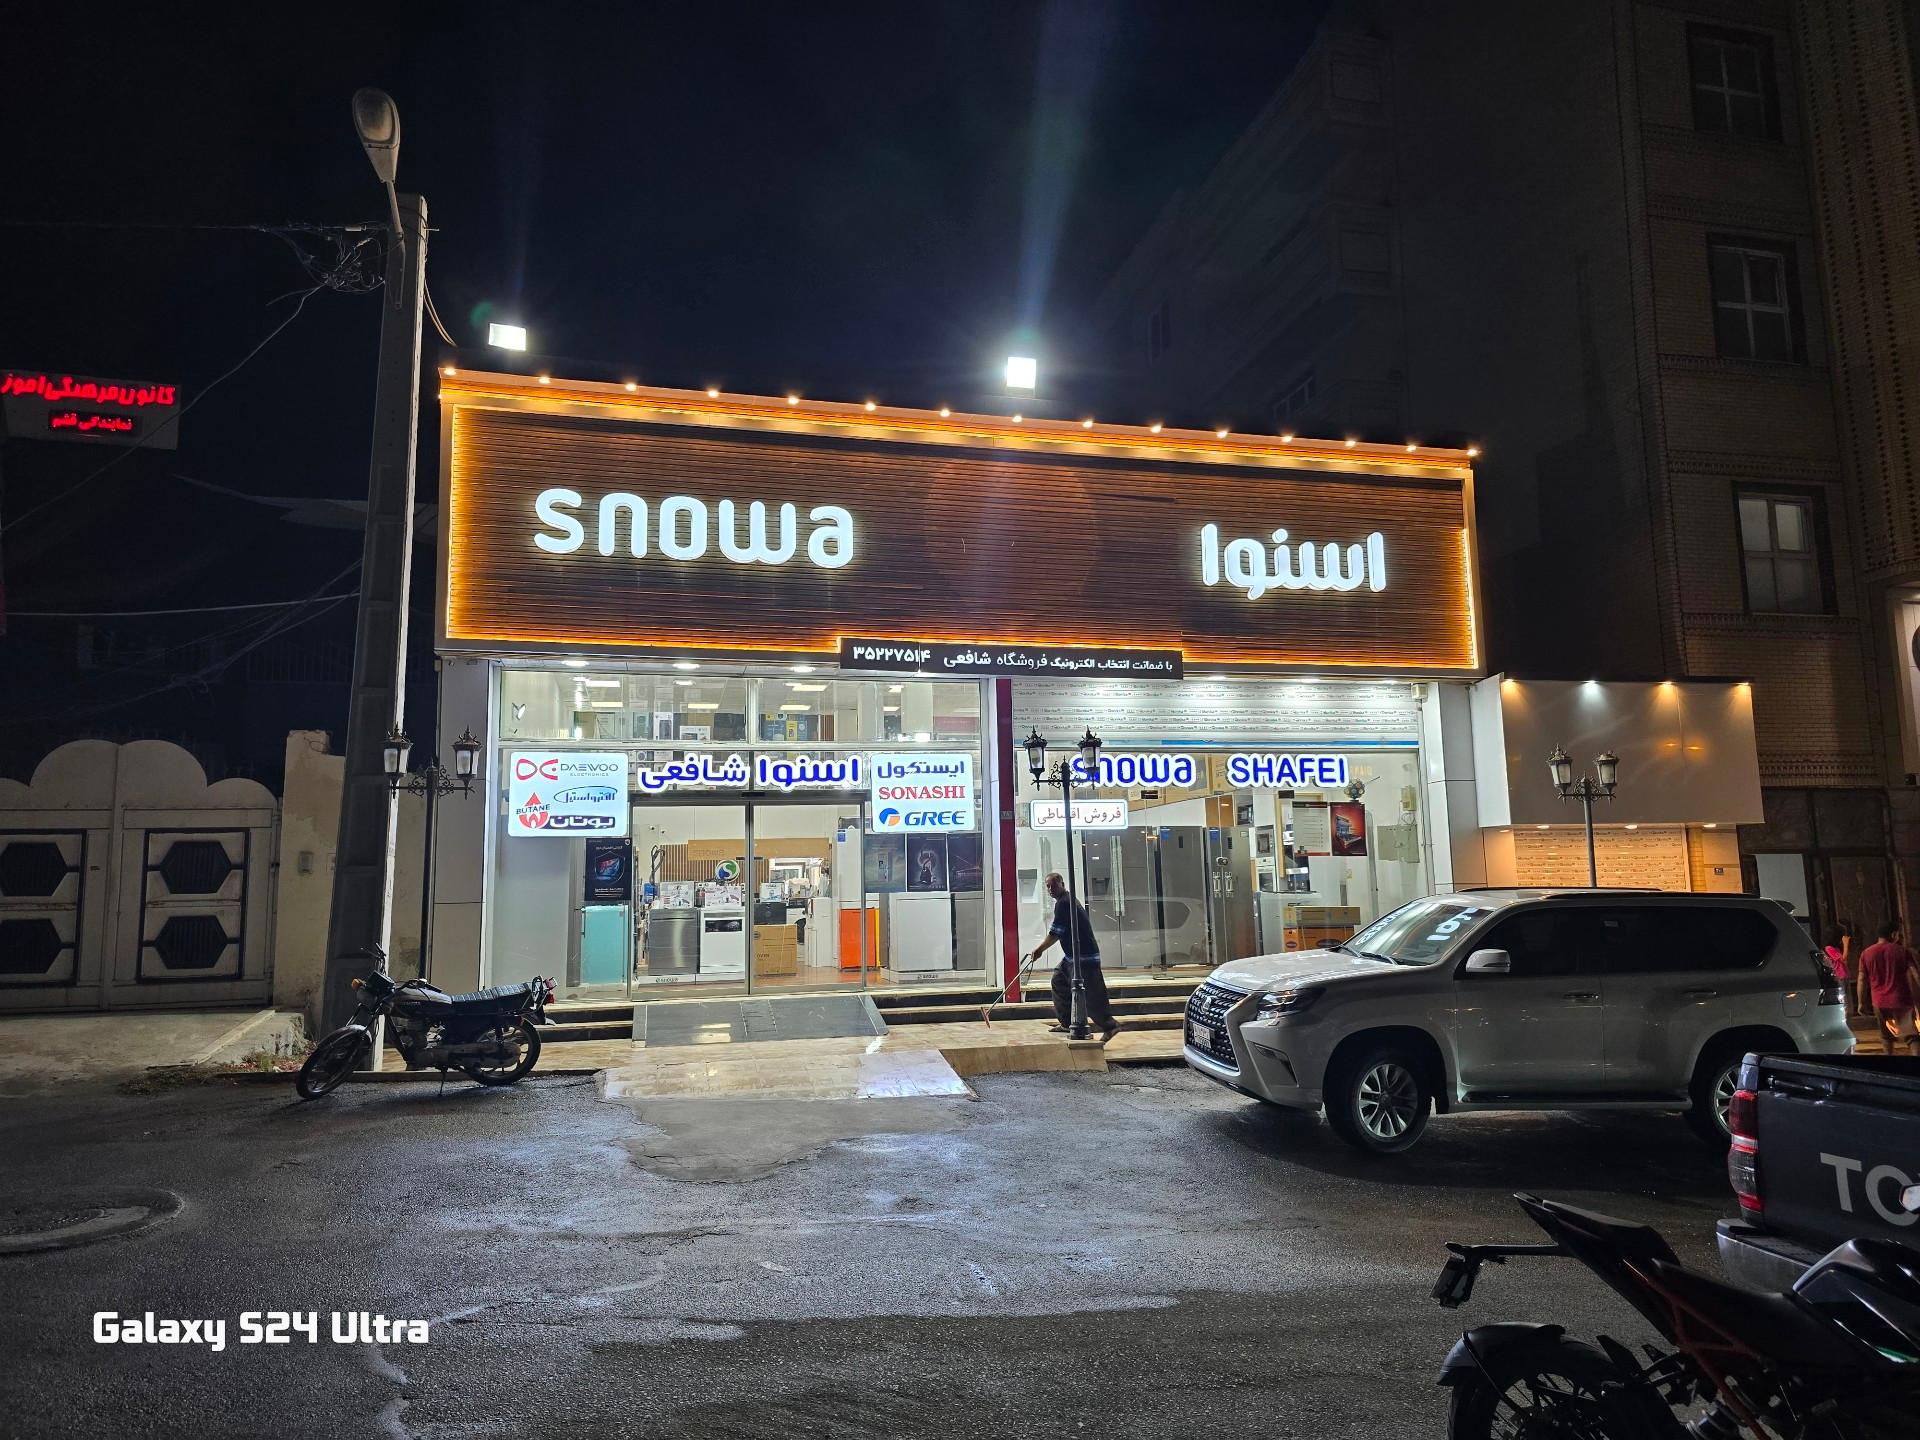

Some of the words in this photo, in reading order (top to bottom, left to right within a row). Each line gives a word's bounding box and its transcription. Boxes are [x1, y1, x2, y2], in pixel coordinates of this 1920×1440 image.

[534, 488, 854, 568] snowa
[1201, 523, 1387, 600] اسنوا
[943, 649, 992, 668] شافعی
[996, 652, 1048, 670] فروشگاه
[1050, 657, 1095, 670] الکترونیک
[1097, 658, 1130, 670] انتخاب
[1132, 659, 1163, 670] ضمانت
[1165, 660, 1173, 672] با
[560, 763, 619, 772] DAEWOO
[640, 755, 748, 790] شافعی
[758, 757, 860, 790] اسنوا
[877, 760, 965, 779] ایستکول
[1230, 756, 1347, 785] SHAFEI
[878, 785, 966, 800] SONASHI
[515, 804, 551, 815] BUTANE
[904, 810, 967, 826] GREE
[1084, 806, 1122, 823] فروش
[549, 816, 614, 829] بوتان
[1820, 1152, 1920, 1227] TO
